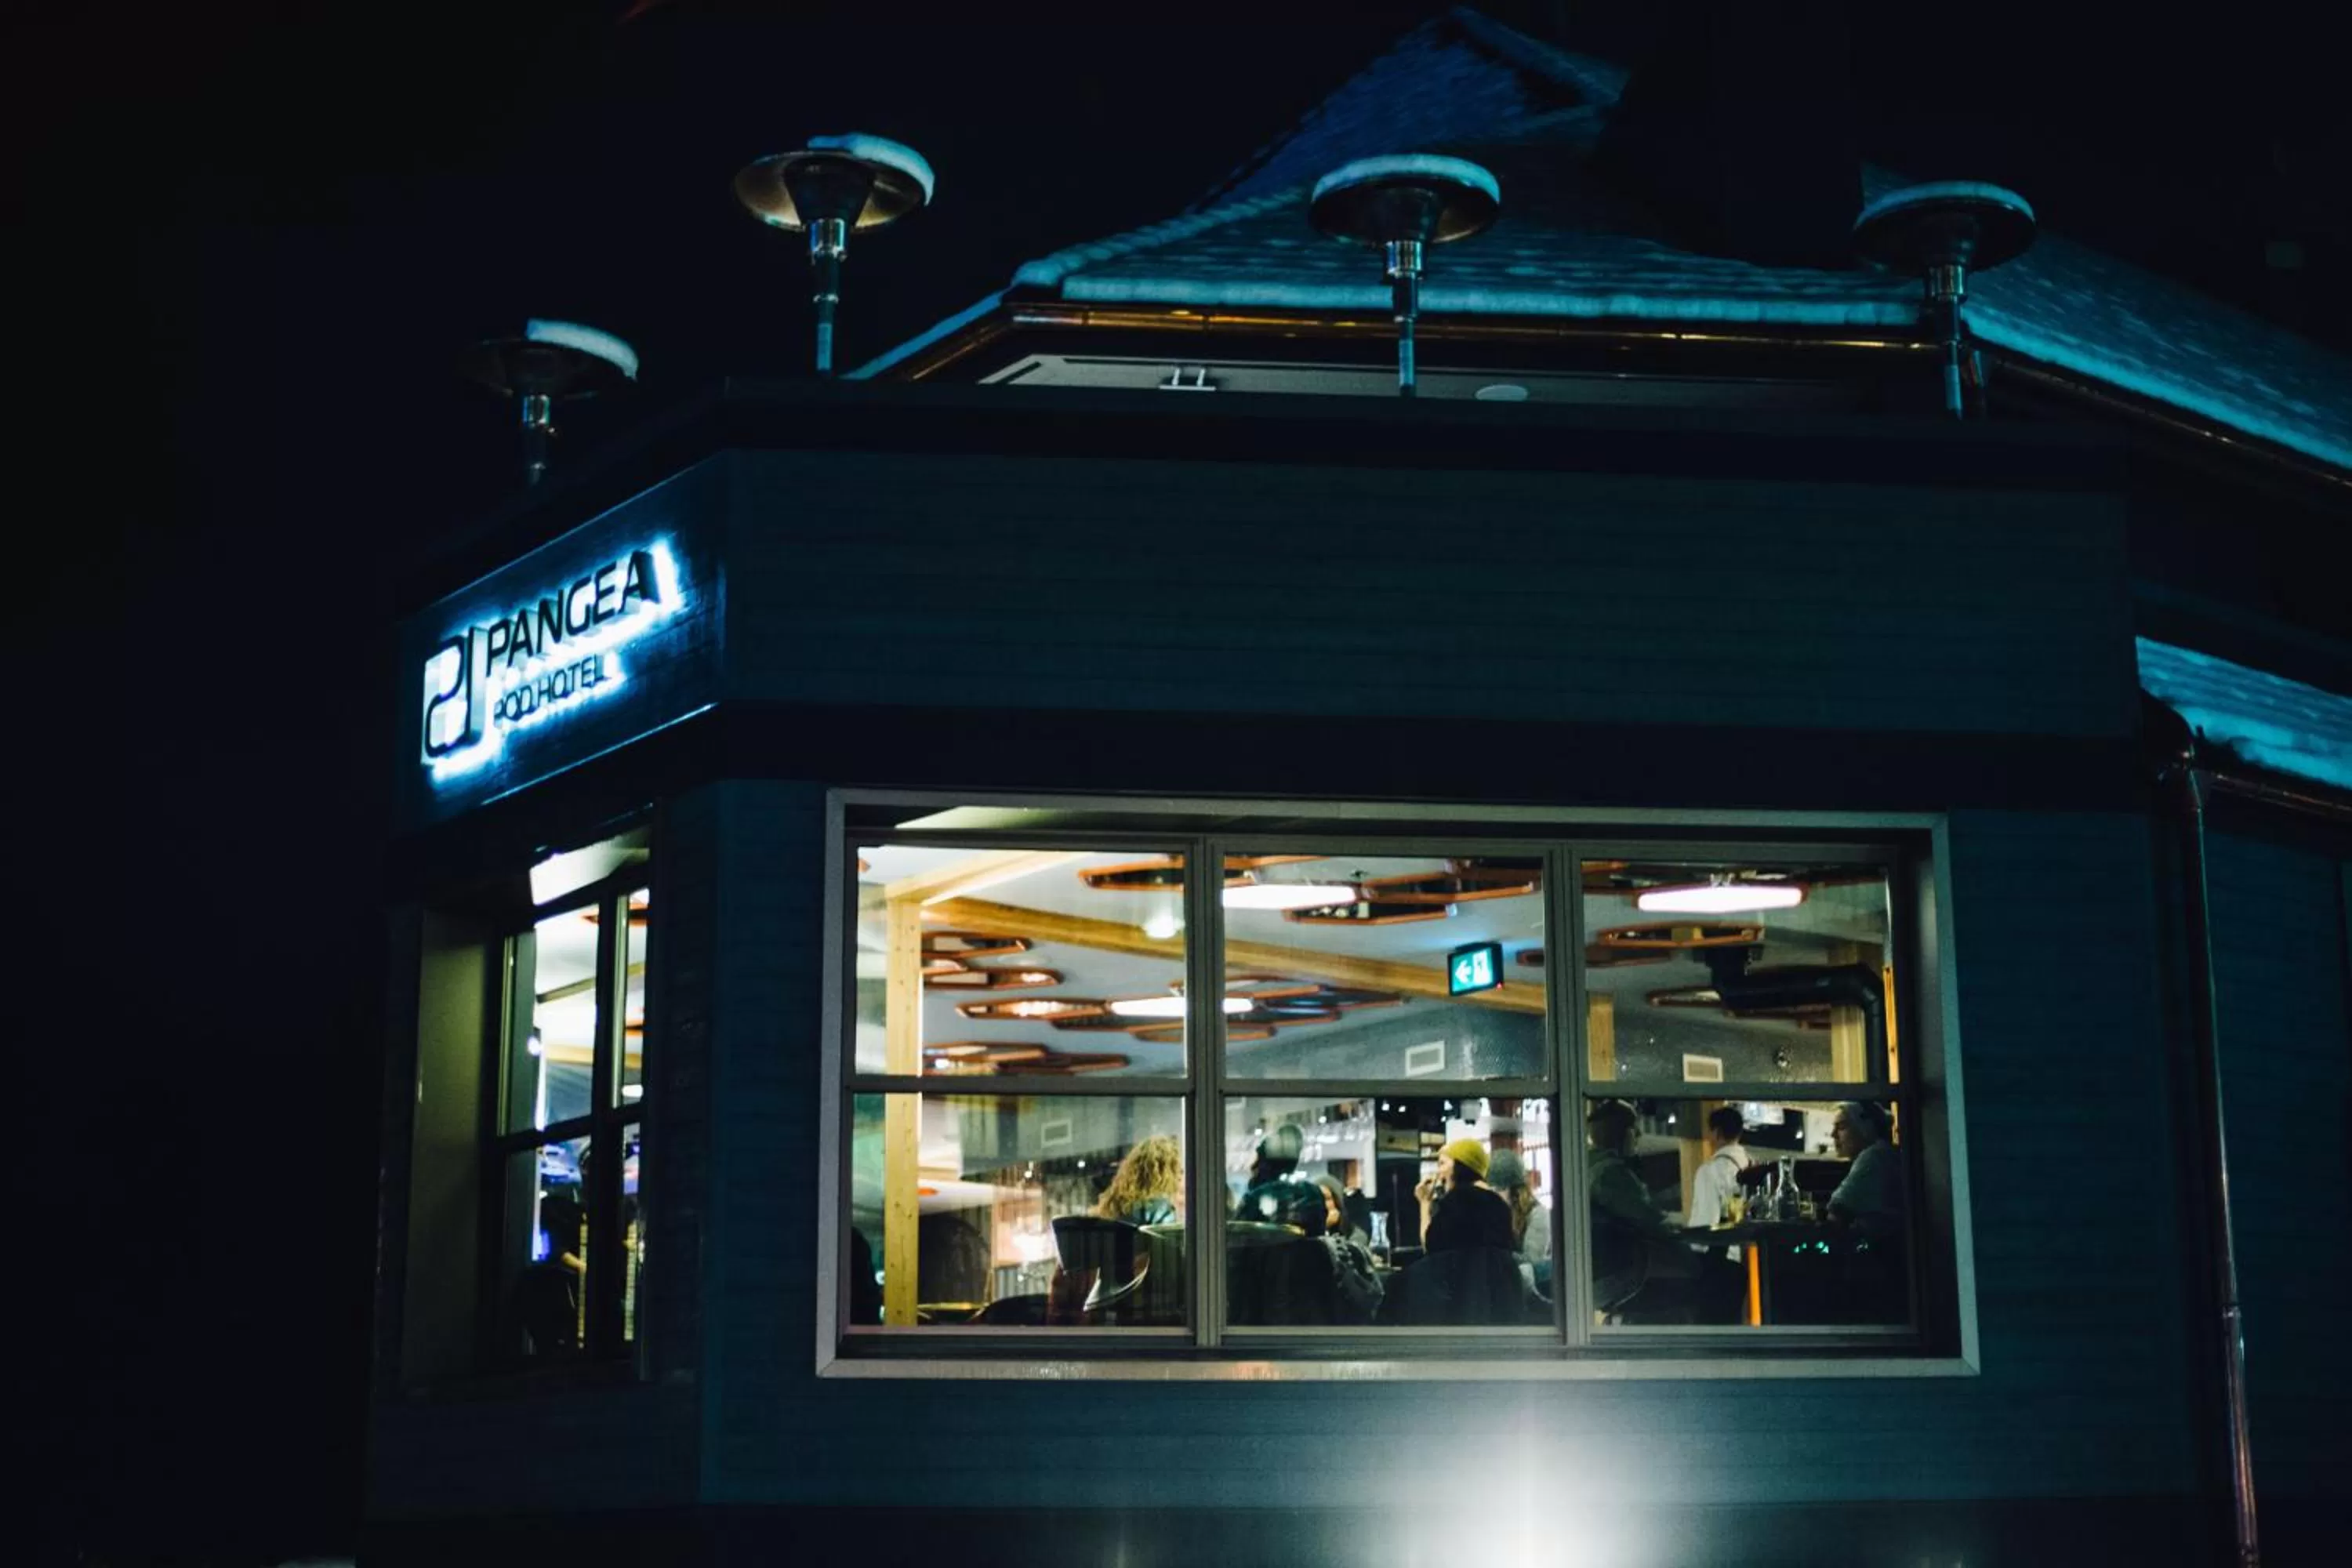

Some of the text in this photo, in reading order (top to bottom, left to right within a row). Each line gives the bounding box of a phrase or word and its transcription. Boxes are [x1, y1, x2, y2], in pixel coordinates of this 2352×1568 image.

[486, 550, 661, 678] PANGEA
[494, 652, 611, 722] POD HOTEL
